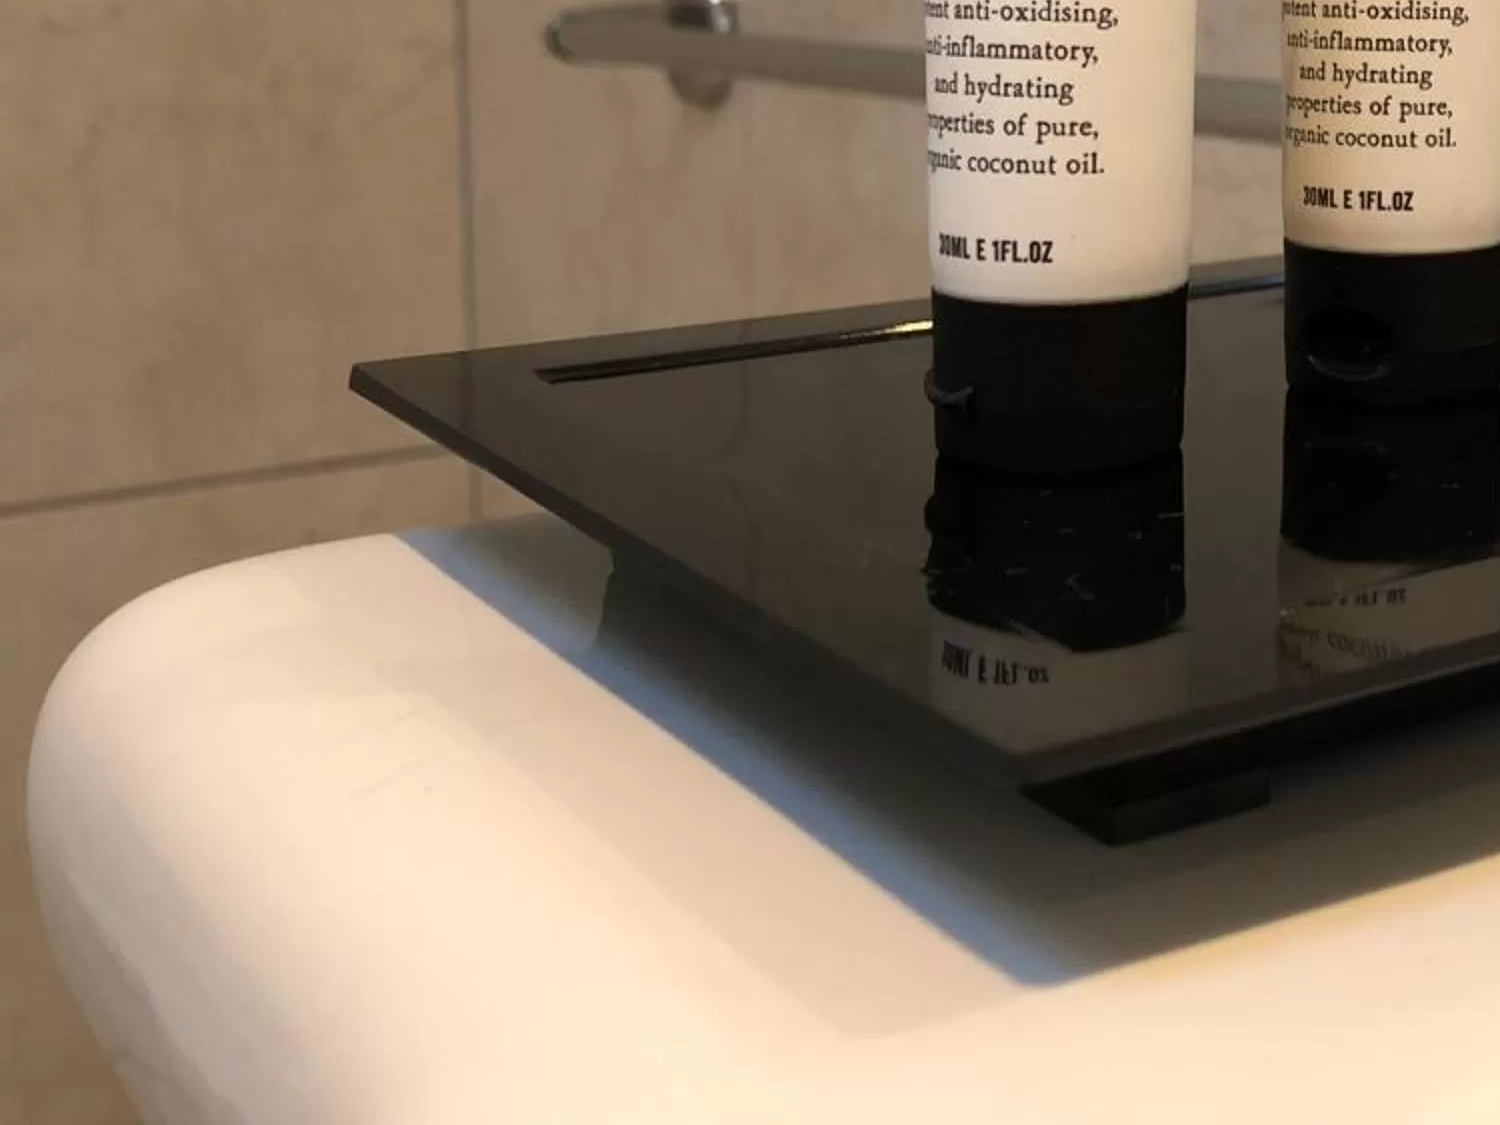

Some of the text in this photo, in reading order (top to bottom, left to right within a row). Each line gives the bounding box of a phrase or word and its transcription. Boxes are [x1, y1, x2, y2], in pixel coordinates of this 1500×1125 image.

[1322, 0, 1469, 26] anti-oxidising,
[935, 71, 1074, 106] and hydrating
[1299, 60, 1433, 90] and hydrating
[1369, 95, 1393, 116] of
[1398, 101, 1453, 123] pure,
[1003, 113, 1028, 135] of
[1036, 120, 1099, 145] pure,
[1335, 130, 1417, 148] coconut
[1425, 127, 1457, 148] oil.
[968, 154, 1057, 175] coconut
[1066, 152, 1105, 174] oil.
[1304, 185, 1339, 208] 30ML
[1359, 190, 1414, 212] 1FL.OZ
[992, 240, 1053, 264] 1FL.OZ
